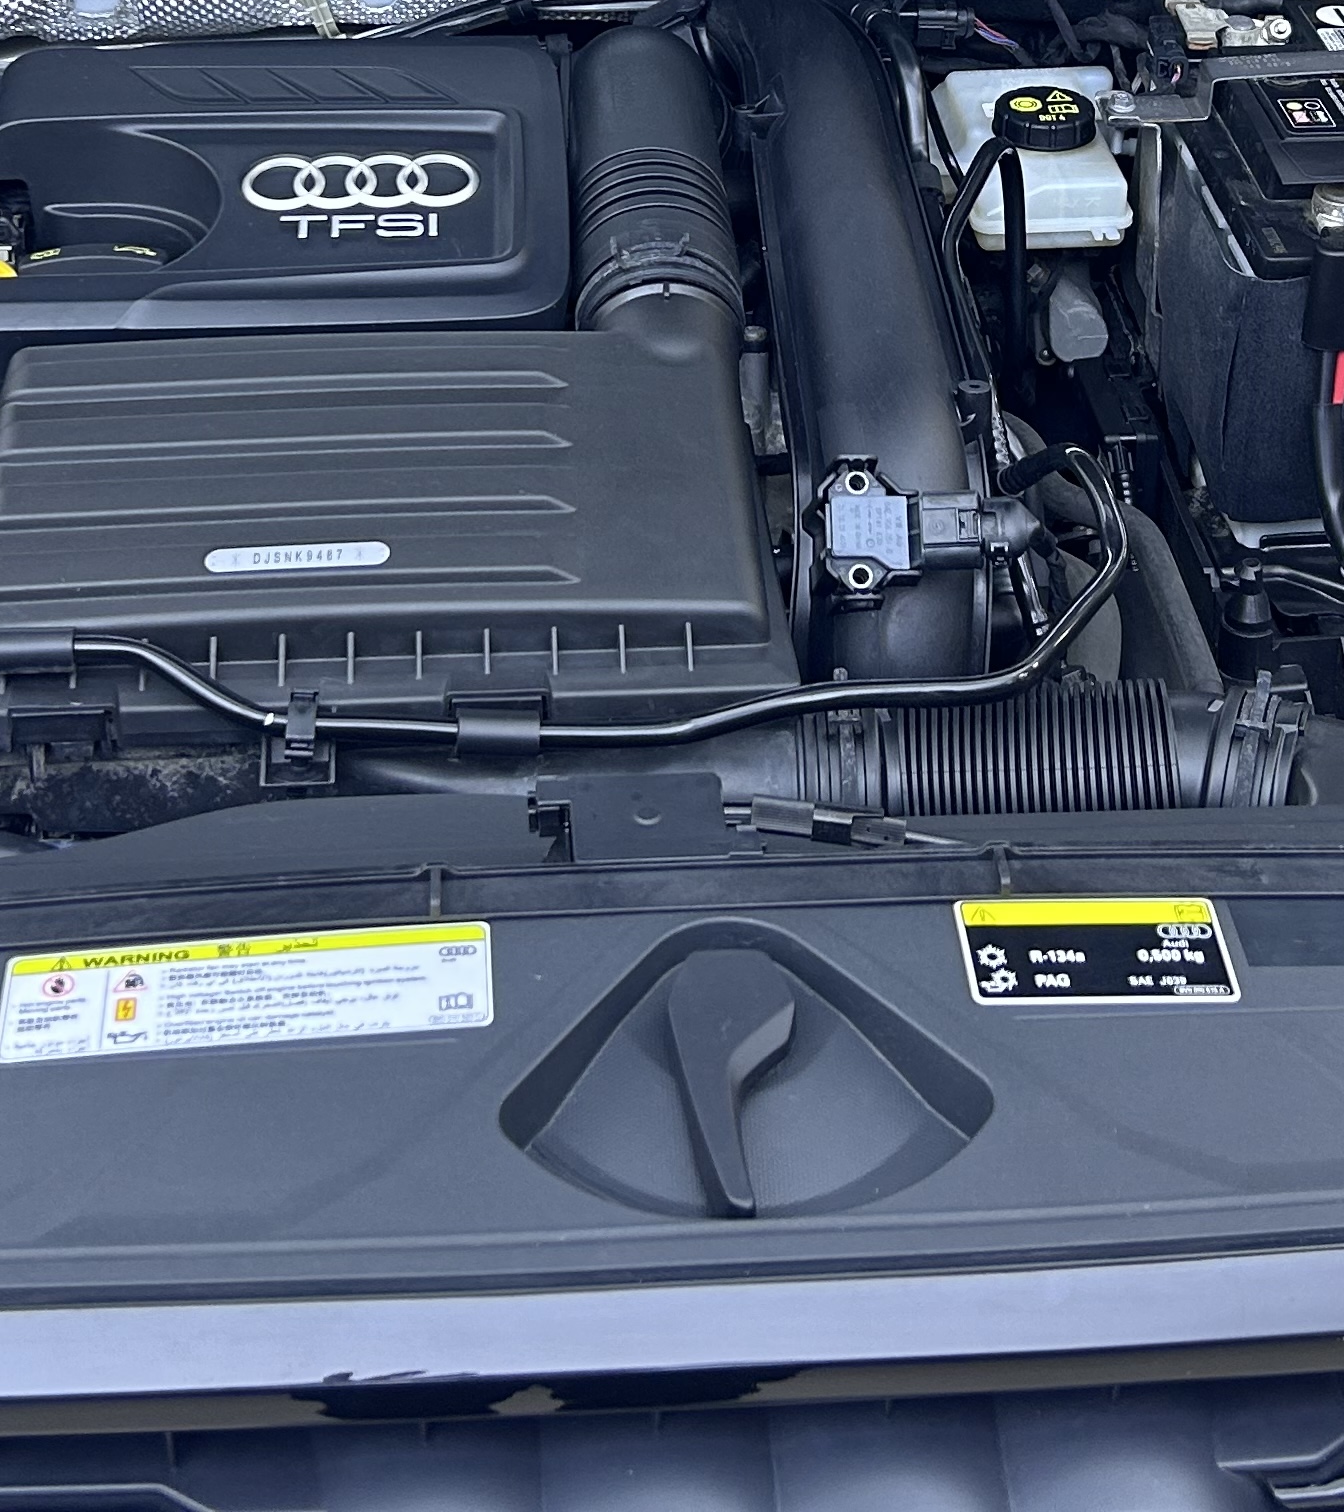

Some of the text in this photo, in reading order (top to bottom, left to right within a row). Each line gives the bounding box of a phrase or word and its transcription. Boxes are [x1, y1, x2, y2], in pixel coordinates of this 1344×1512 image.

[279, 212, 439, 239] TFSI
[82, 949, 191, 969] WARNING
[1028, 948, 1087, 964] R-134a
[1182, 948, 1205, 965] kg
